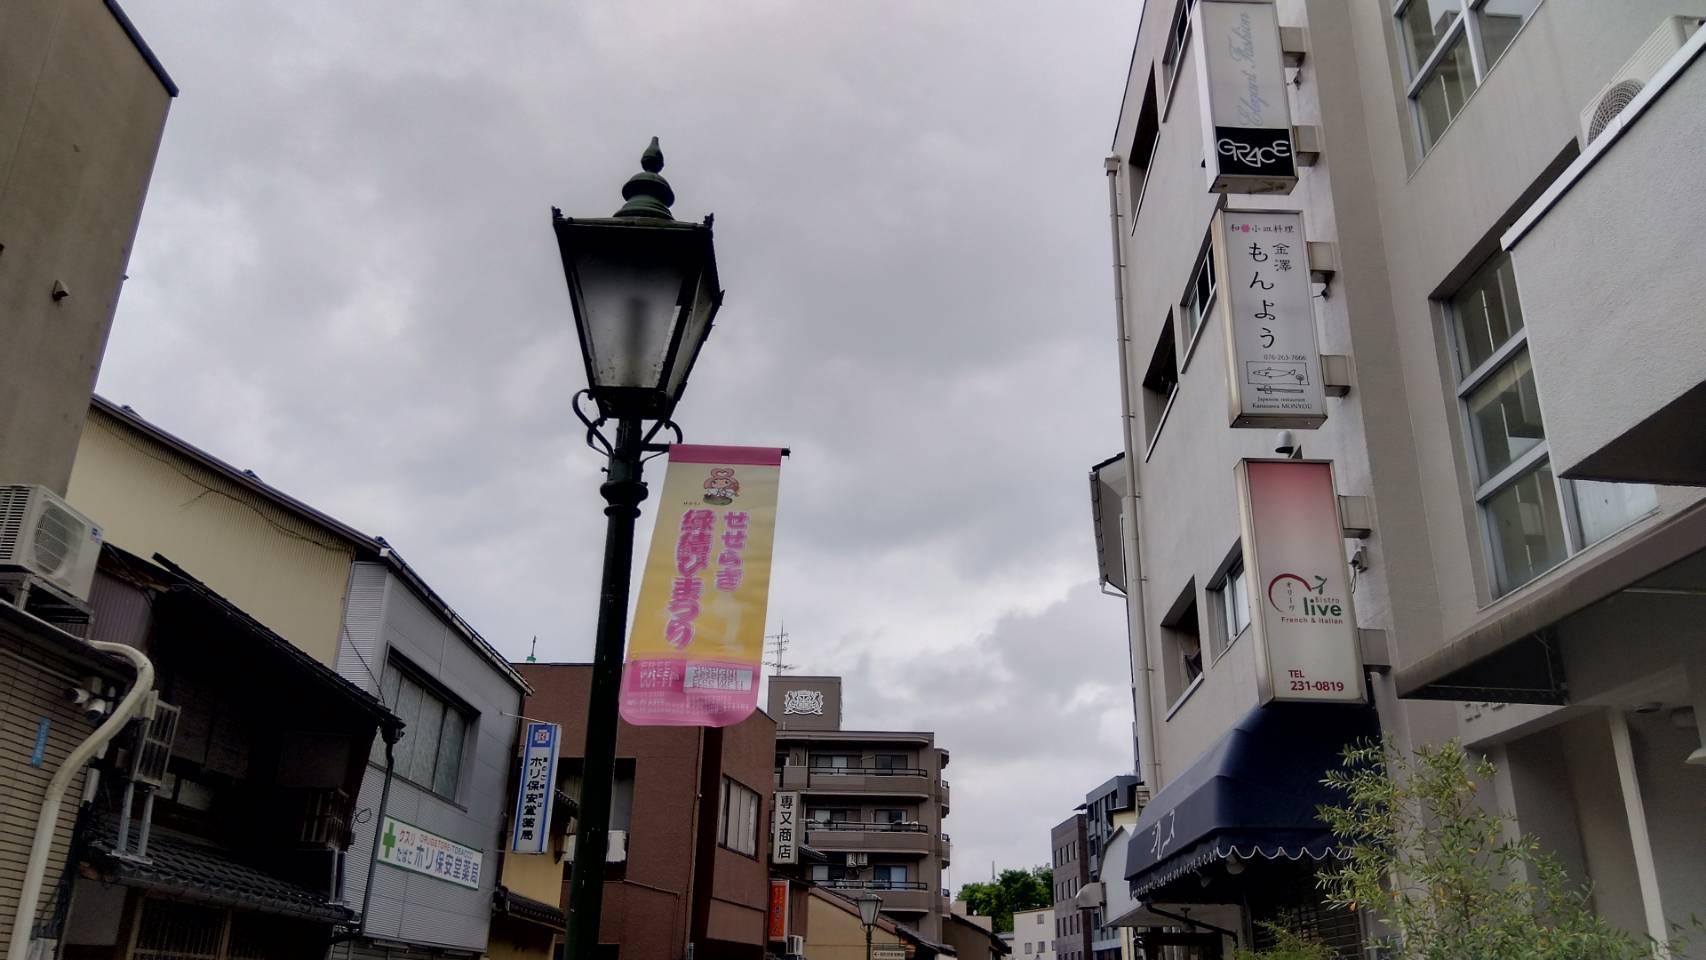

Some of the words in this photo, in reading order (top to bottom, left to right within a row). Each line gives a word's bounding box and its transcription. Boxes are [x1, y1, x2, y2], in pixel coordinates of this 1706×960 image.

[1217, 138, 1291, 168] GRACE
[1249, 242, 1276, 349] もんよう
[1289, 670, 1305, 679] TEL
[1291, 681, 1344, 692] 231-0819
[520, 757, 543, 841] ホリ保安堂薬局
[399, 830, 416, 847] クスリ
[397, 848, 413, 865] たばこ
